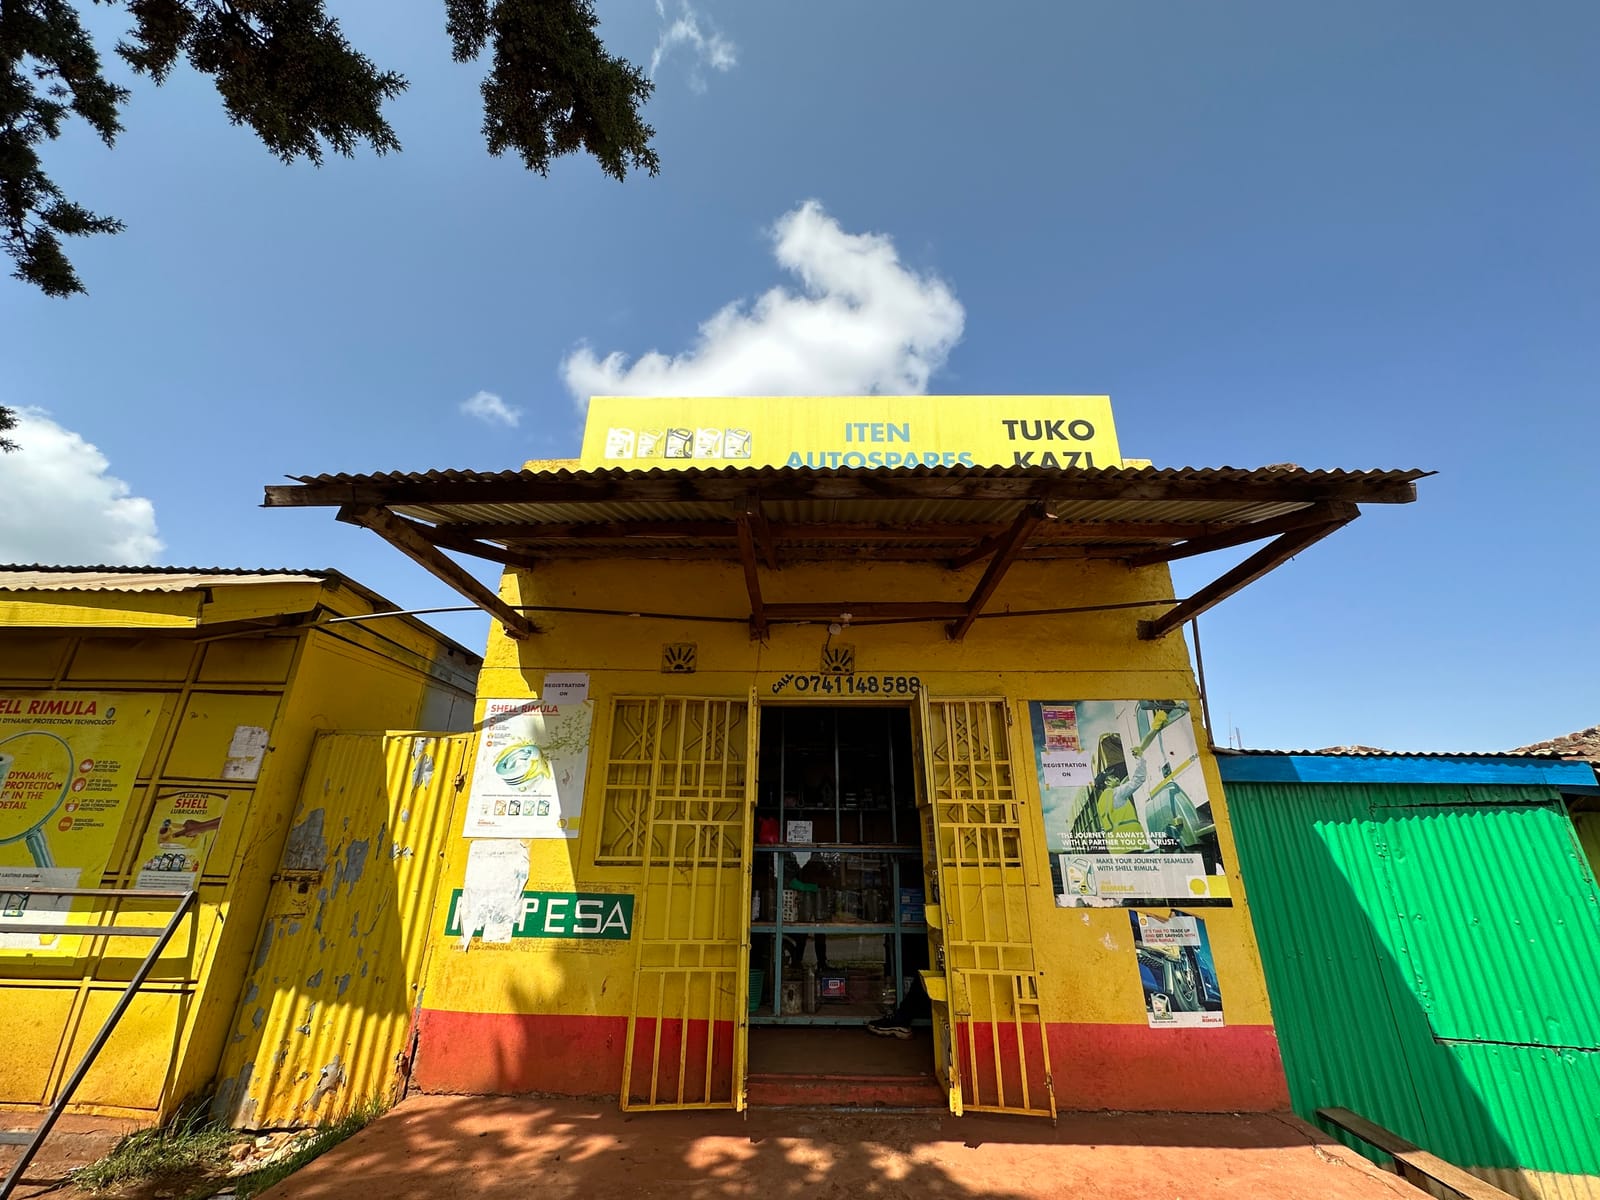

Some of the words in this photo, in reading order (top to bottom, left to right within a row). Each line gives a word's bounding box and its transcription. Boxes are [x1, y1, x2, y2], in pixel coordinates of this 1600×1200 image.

[845, 422, 910, 443] ITEN
[1002, 419, 1095, 440] TUKO
[786, 451, 974, 469] AUTOSPARES
[1013, 451, 1094, 469] KAZI
[27, 700, 97, 715] RIMULA
[490, 704, 518, 713] SHELL
[521, 704, 559, 713] RIMULA
[8, 771, 54, 780] DYNAMIC
[4, 781, 63, 790] PROTECTION
[11, 791, 24, 799] IN
[26, 791, 44, 800] THE
[175, 799, 208, 809] SHELL
[1075, 831, 1105, 839] JOURNEY
[450, 896, 629, 935] PESA
